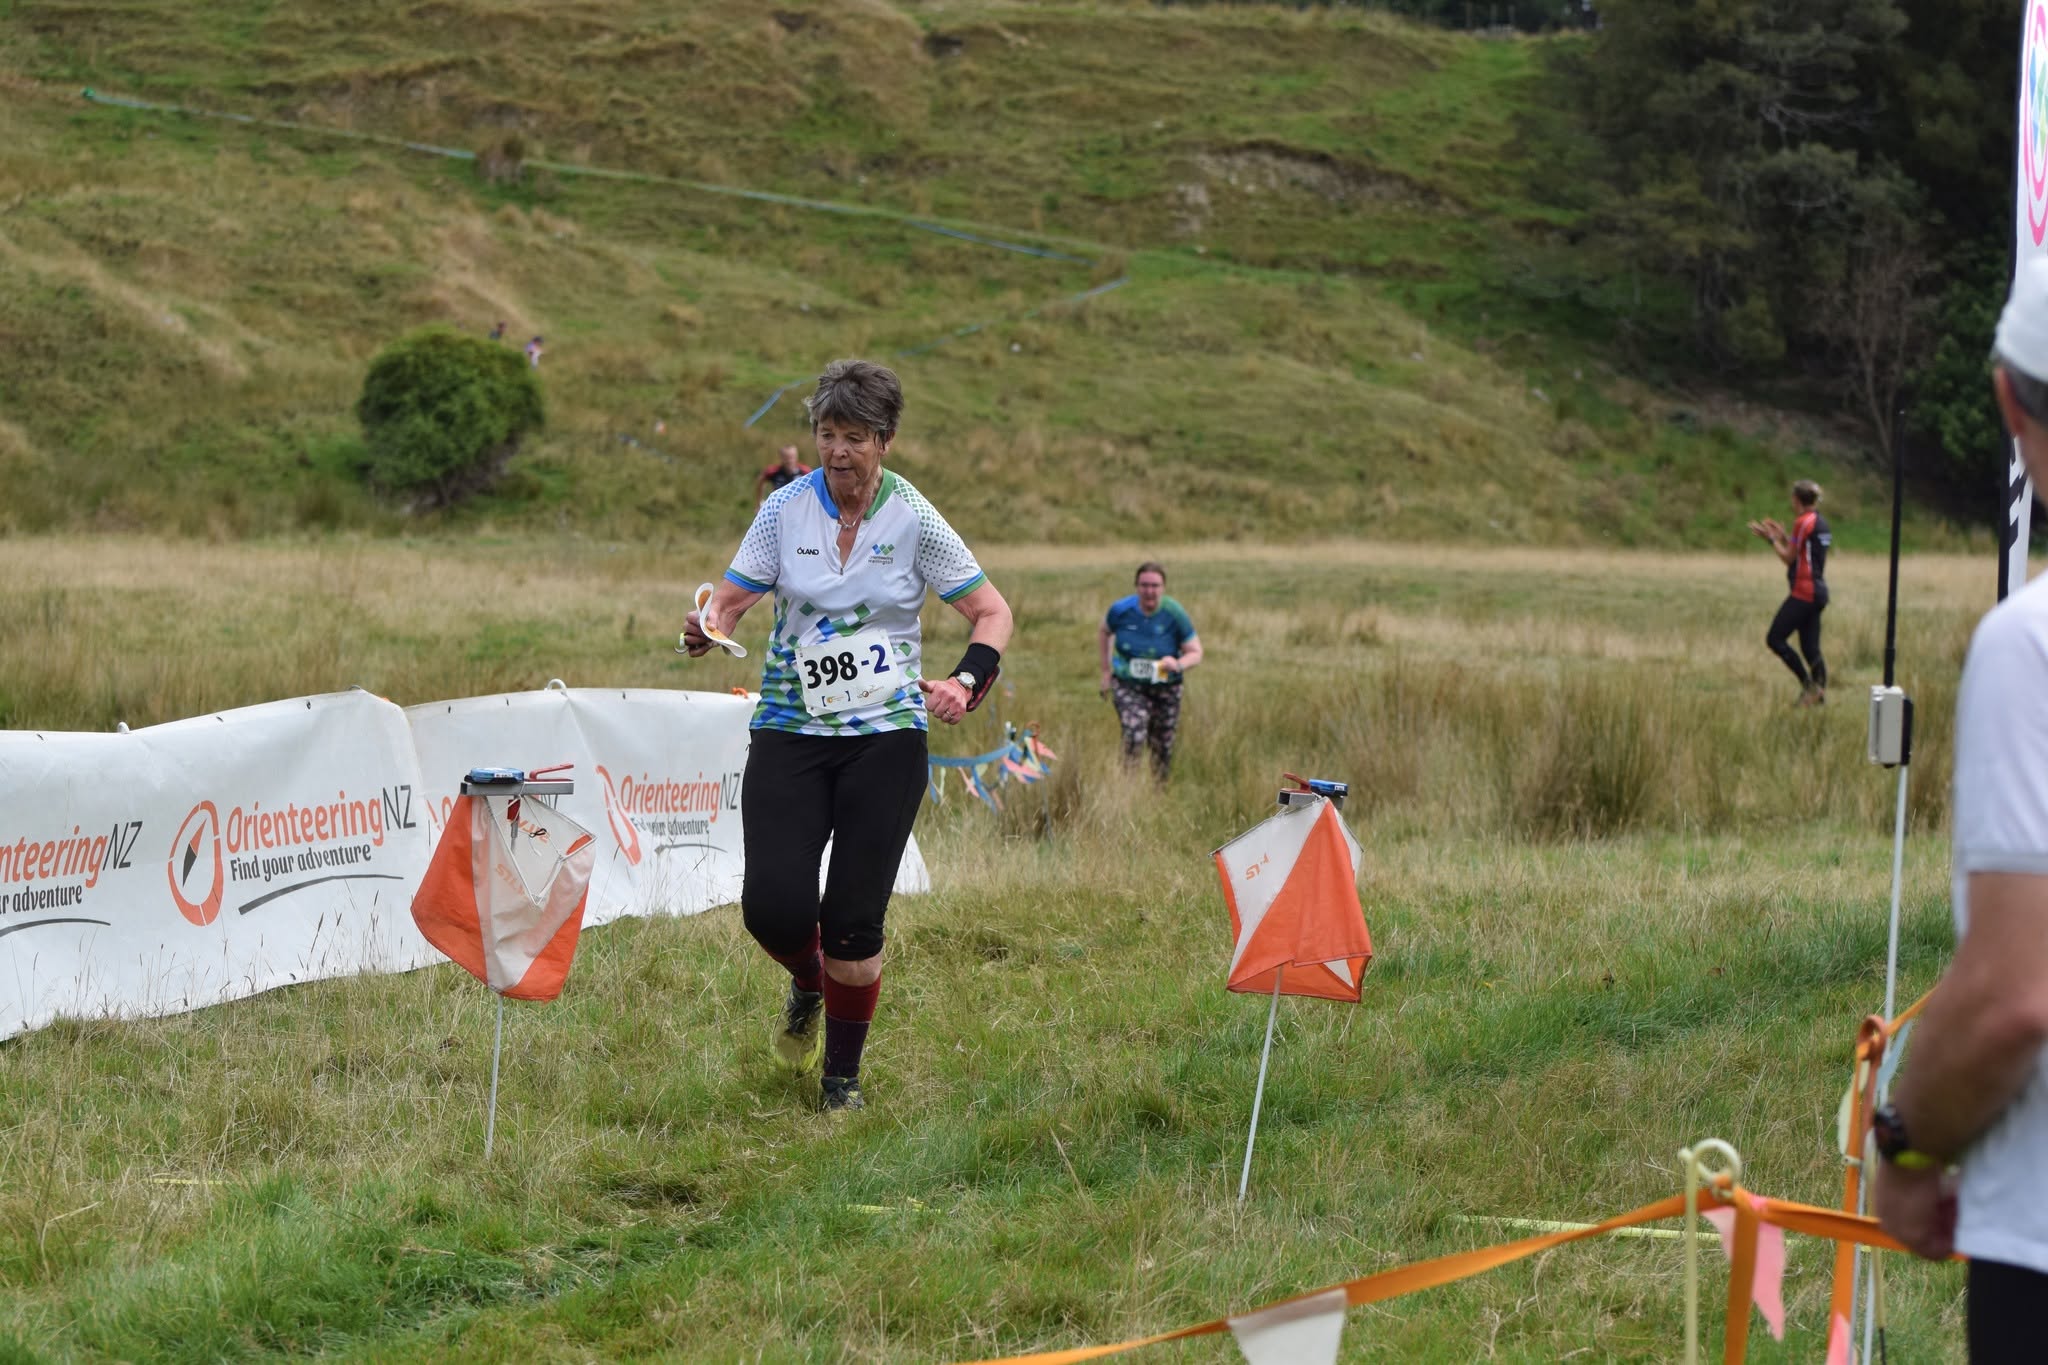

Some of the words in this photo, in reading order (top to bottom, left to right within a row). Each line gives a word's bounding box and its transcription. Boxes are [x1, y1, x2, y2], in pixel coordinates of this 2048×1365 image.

[803, 644, 890, 690] 398-2
[226, 784, 416, 854] OrienteeringNZ
[667, 817, 710, 836] adventure
[230, 855, 261, 881] Find
[262, 855, 294, 882] your
[297, 844, 372, 871] adventure
[12, 885, 83, 913] adventure
